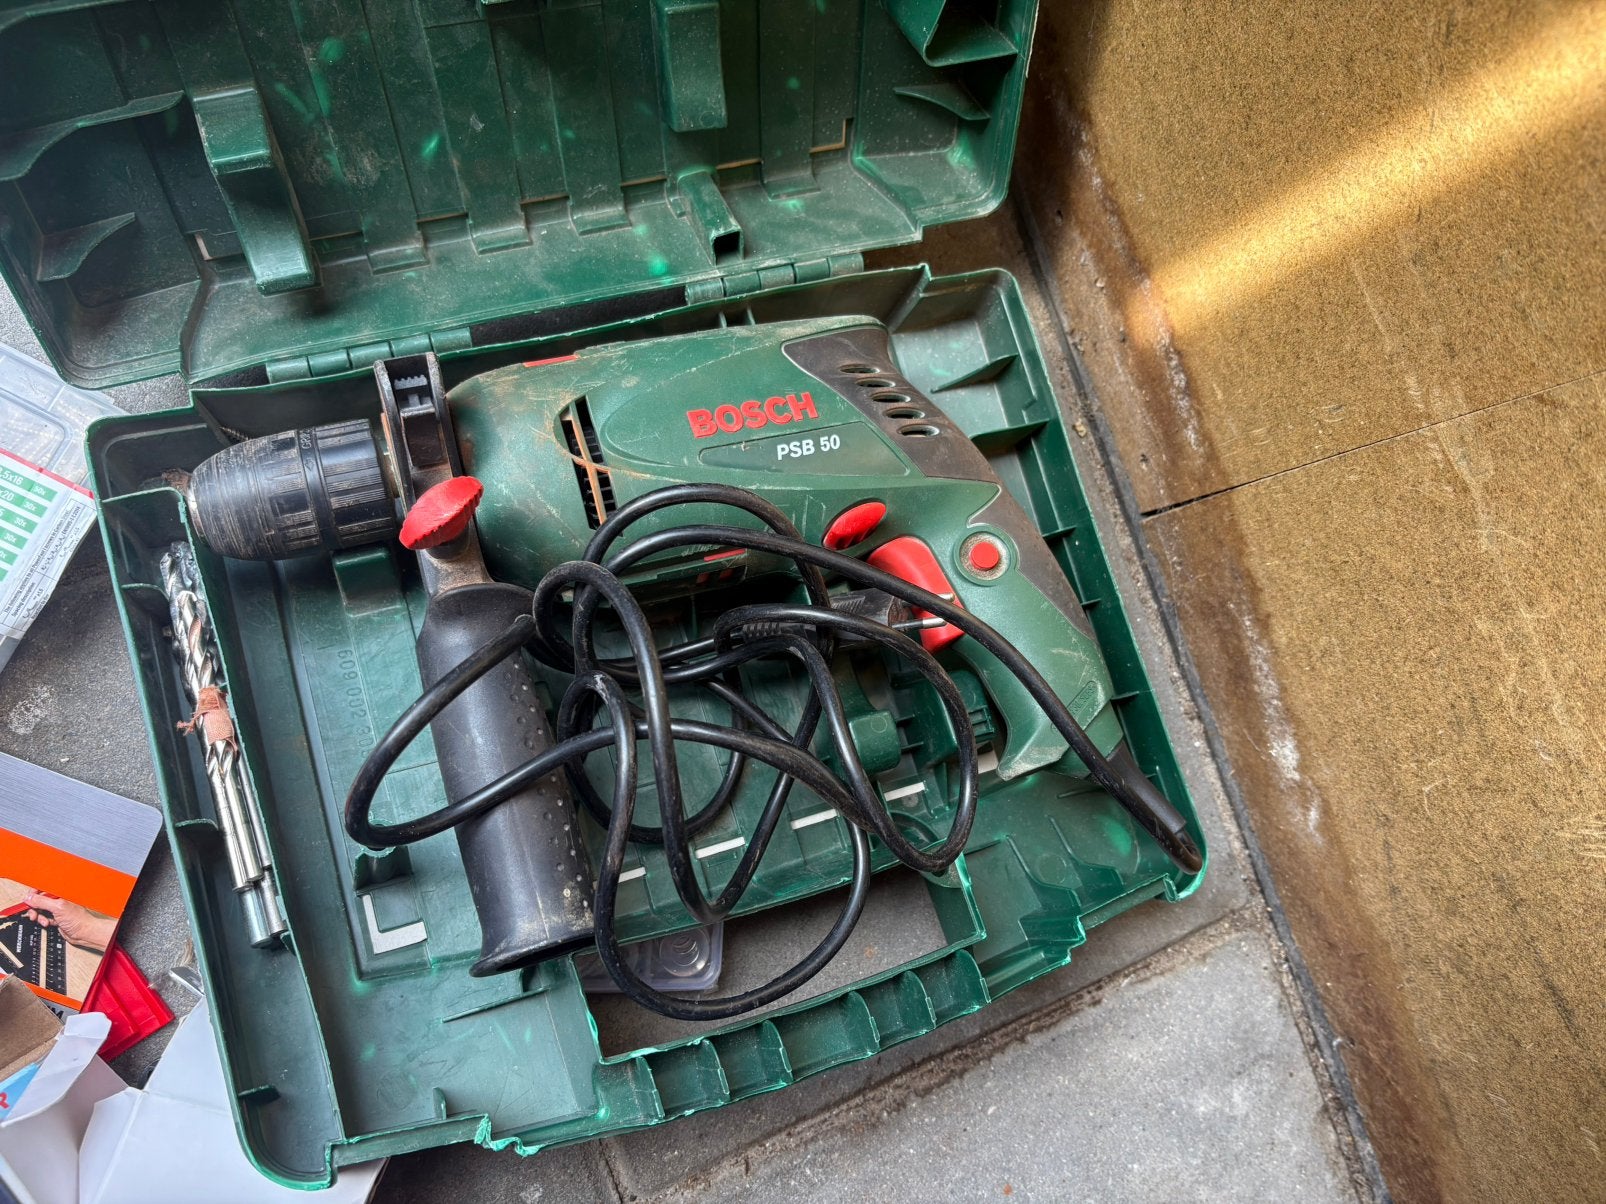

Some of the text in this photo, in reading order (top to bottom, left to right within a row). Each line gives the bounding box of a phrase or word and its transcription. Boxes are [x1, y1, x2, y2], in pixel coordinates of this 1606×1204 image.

[687, 392, 819, 438] BOSCH
[777, 434, 841, 460] PSB 50
[337, 649, 358, 680] 609
[346, 686, 367, 719] 002
